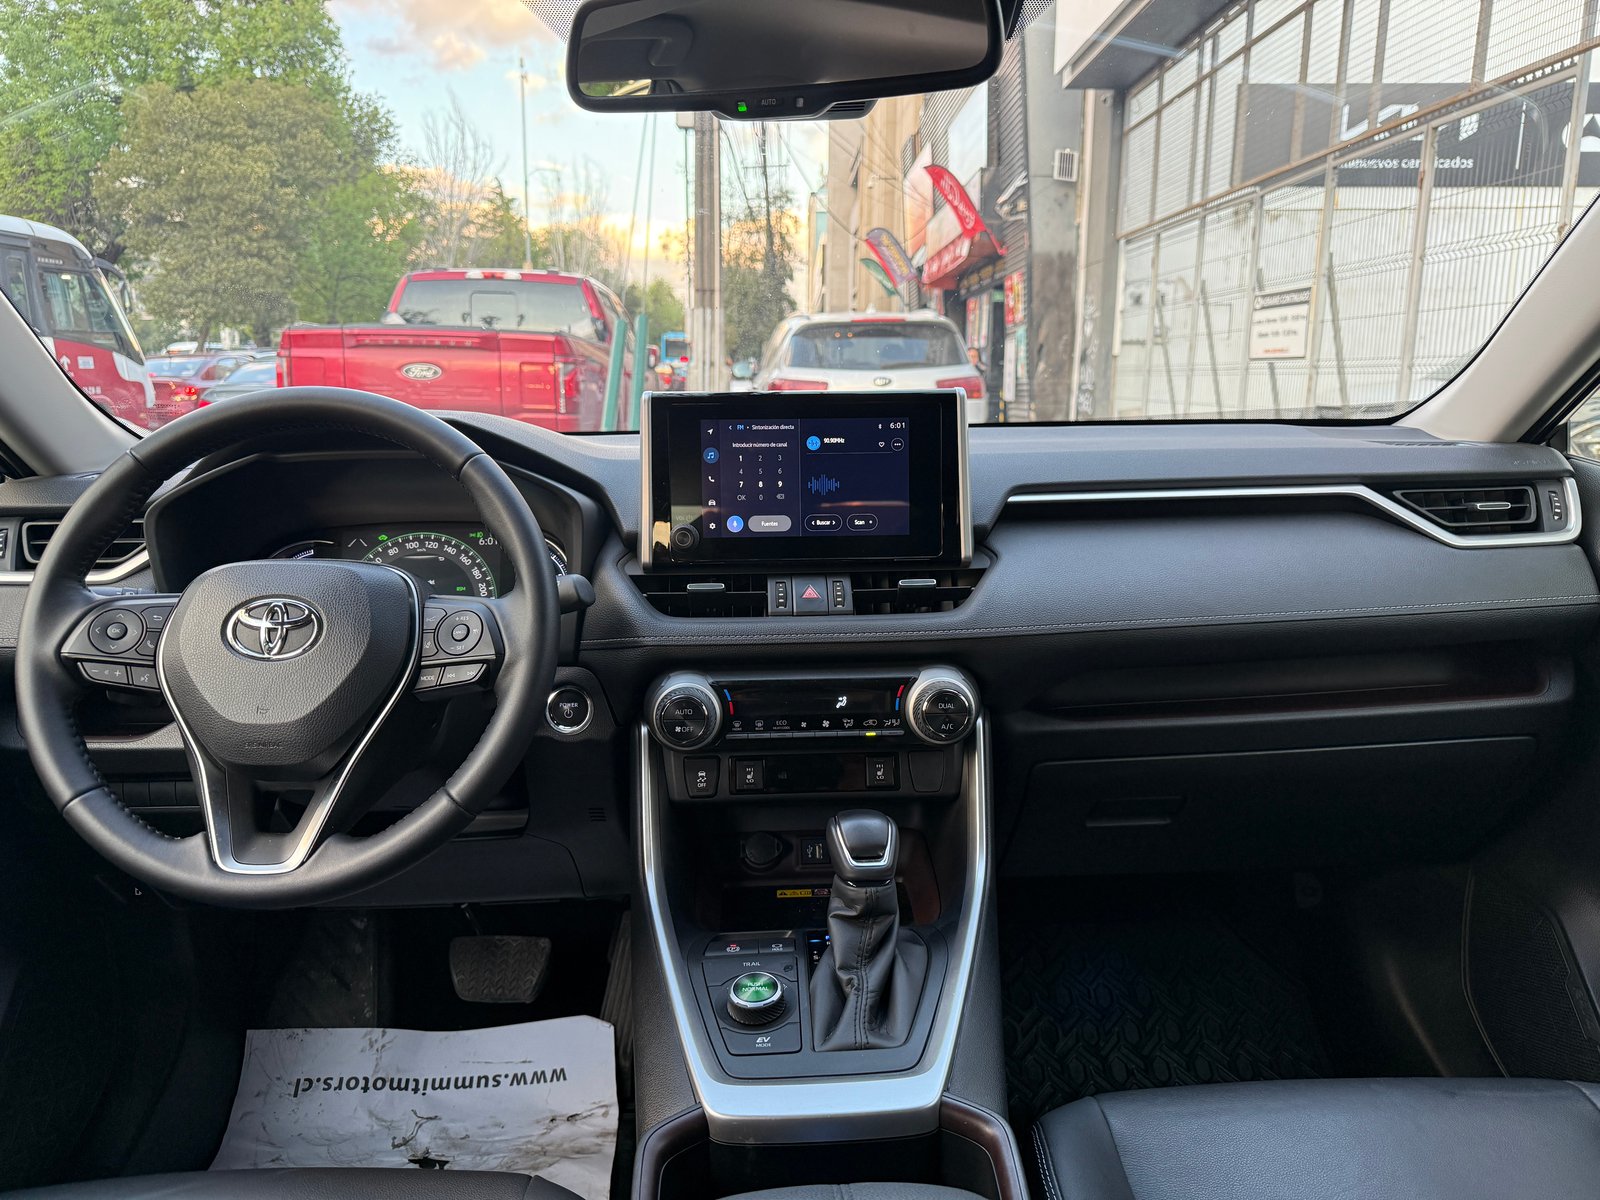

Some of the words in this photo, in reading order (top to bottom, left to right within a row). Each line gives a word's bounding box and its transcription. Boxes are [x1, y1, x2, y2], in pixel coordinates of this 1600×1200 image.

[761, 98, 777, 106] AUTO
[1401, 155, 1474, 169] cericados
[407, 366, 436, 379] Ford
[777, 467, 783, 475] 6
[777, 480, 783, 488] 9
[404, 541, 420, 550] 100
[424, 541, 439, 549] 120
[443, 544, 457, 555] 140
[387, 546, 399, 556] 80
[459, 553, 472, 566] 160
[471, 566, 482, 580] 180
[478, 582, 488, 597] 200
[293, 1067, 568, 1098] www.summitmotors.cl
